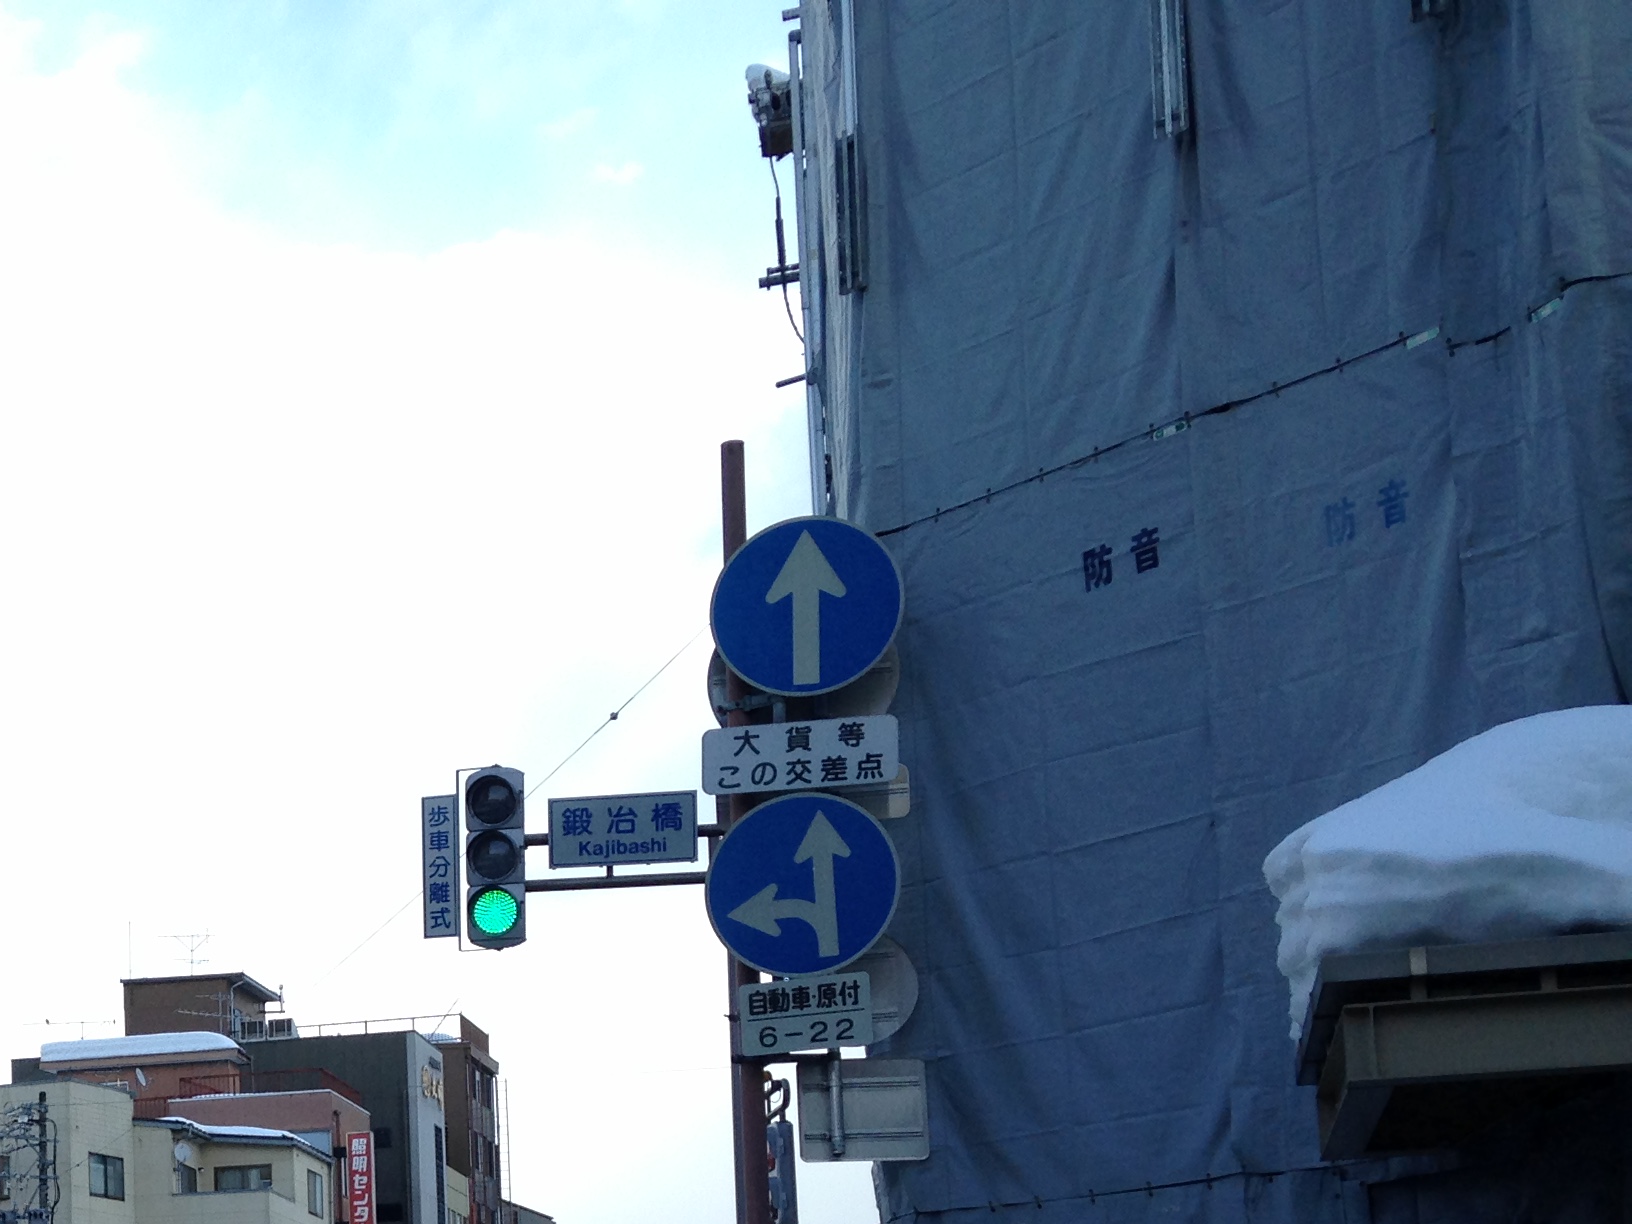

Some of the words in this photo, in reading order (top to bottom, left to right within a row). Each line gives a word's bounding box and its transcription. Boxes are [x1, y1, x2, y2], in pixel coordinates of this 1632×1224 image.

[1321, 478, 1411, 549] 防音
[1081, 527, 1162, 592] 防音
[733, 721, 865, 757] 大貨等
[718, 752, 884, 789] この交差点
[561, 802, 683, 836] 鍛冶橋
[578, 836, 667, 858] Kajibashi
[427, 804, 452, 931] 歩車分離式
[759, 1018, 855, 1048] 6-22
